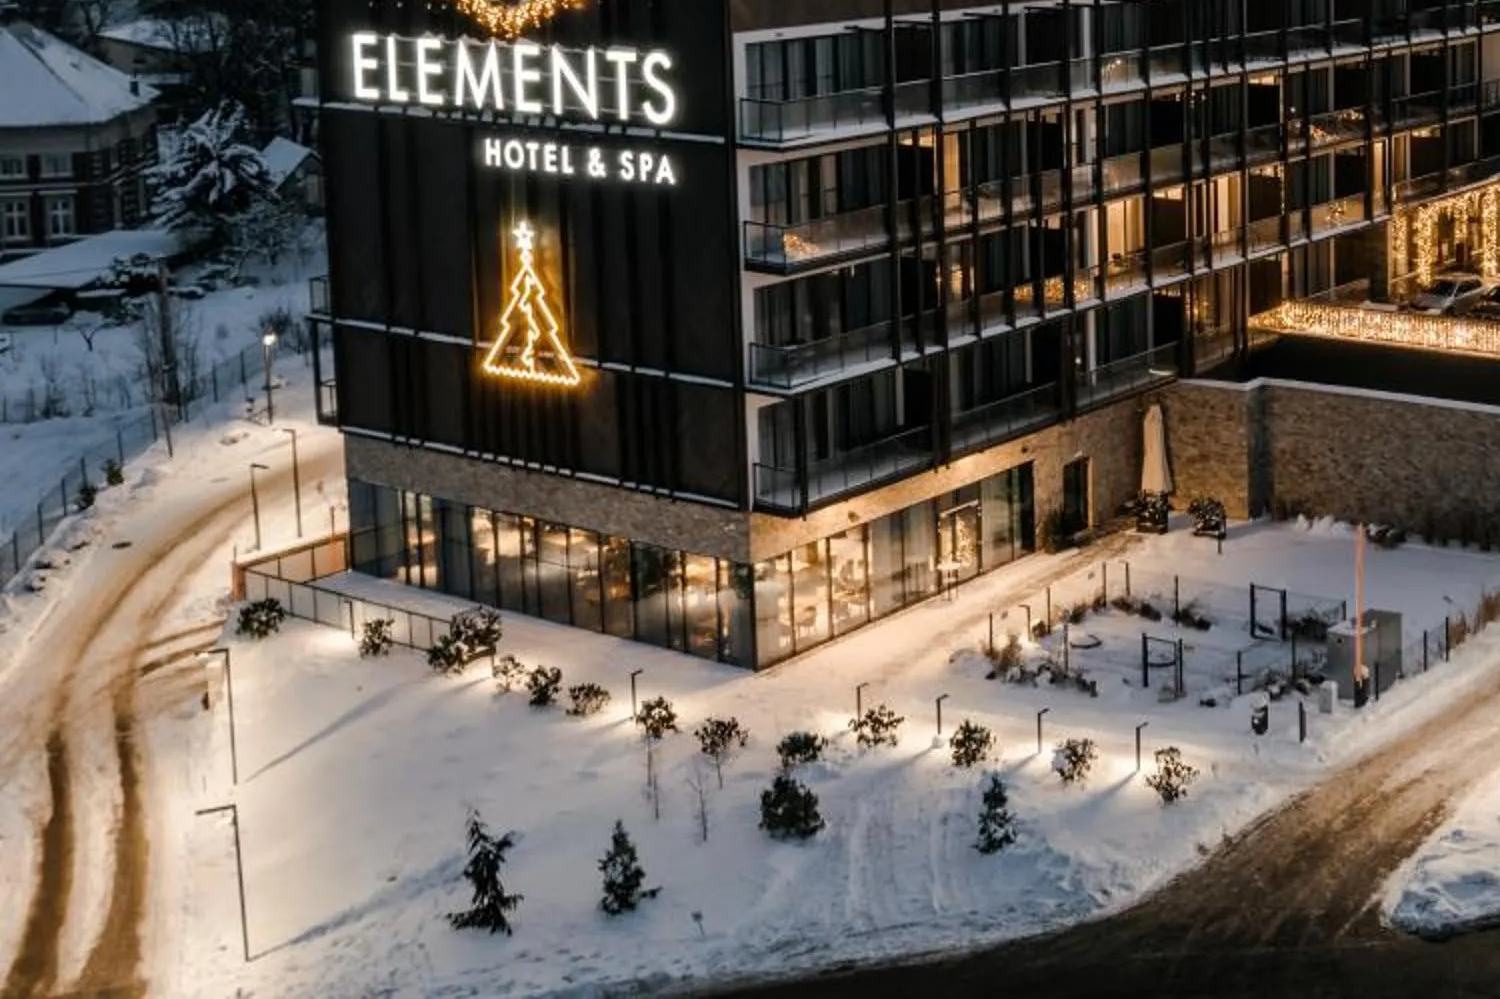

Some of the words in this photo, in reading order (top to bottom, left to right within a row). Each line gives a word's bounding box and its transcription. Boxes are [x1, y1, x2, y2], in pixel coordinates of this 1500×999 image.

[350, 32, 677, 126] ELEMENTS
[483, 137, 575, 175] HOTEL
[585, 147, 607, 179] &
[617, 150, 677, 186] SPA
